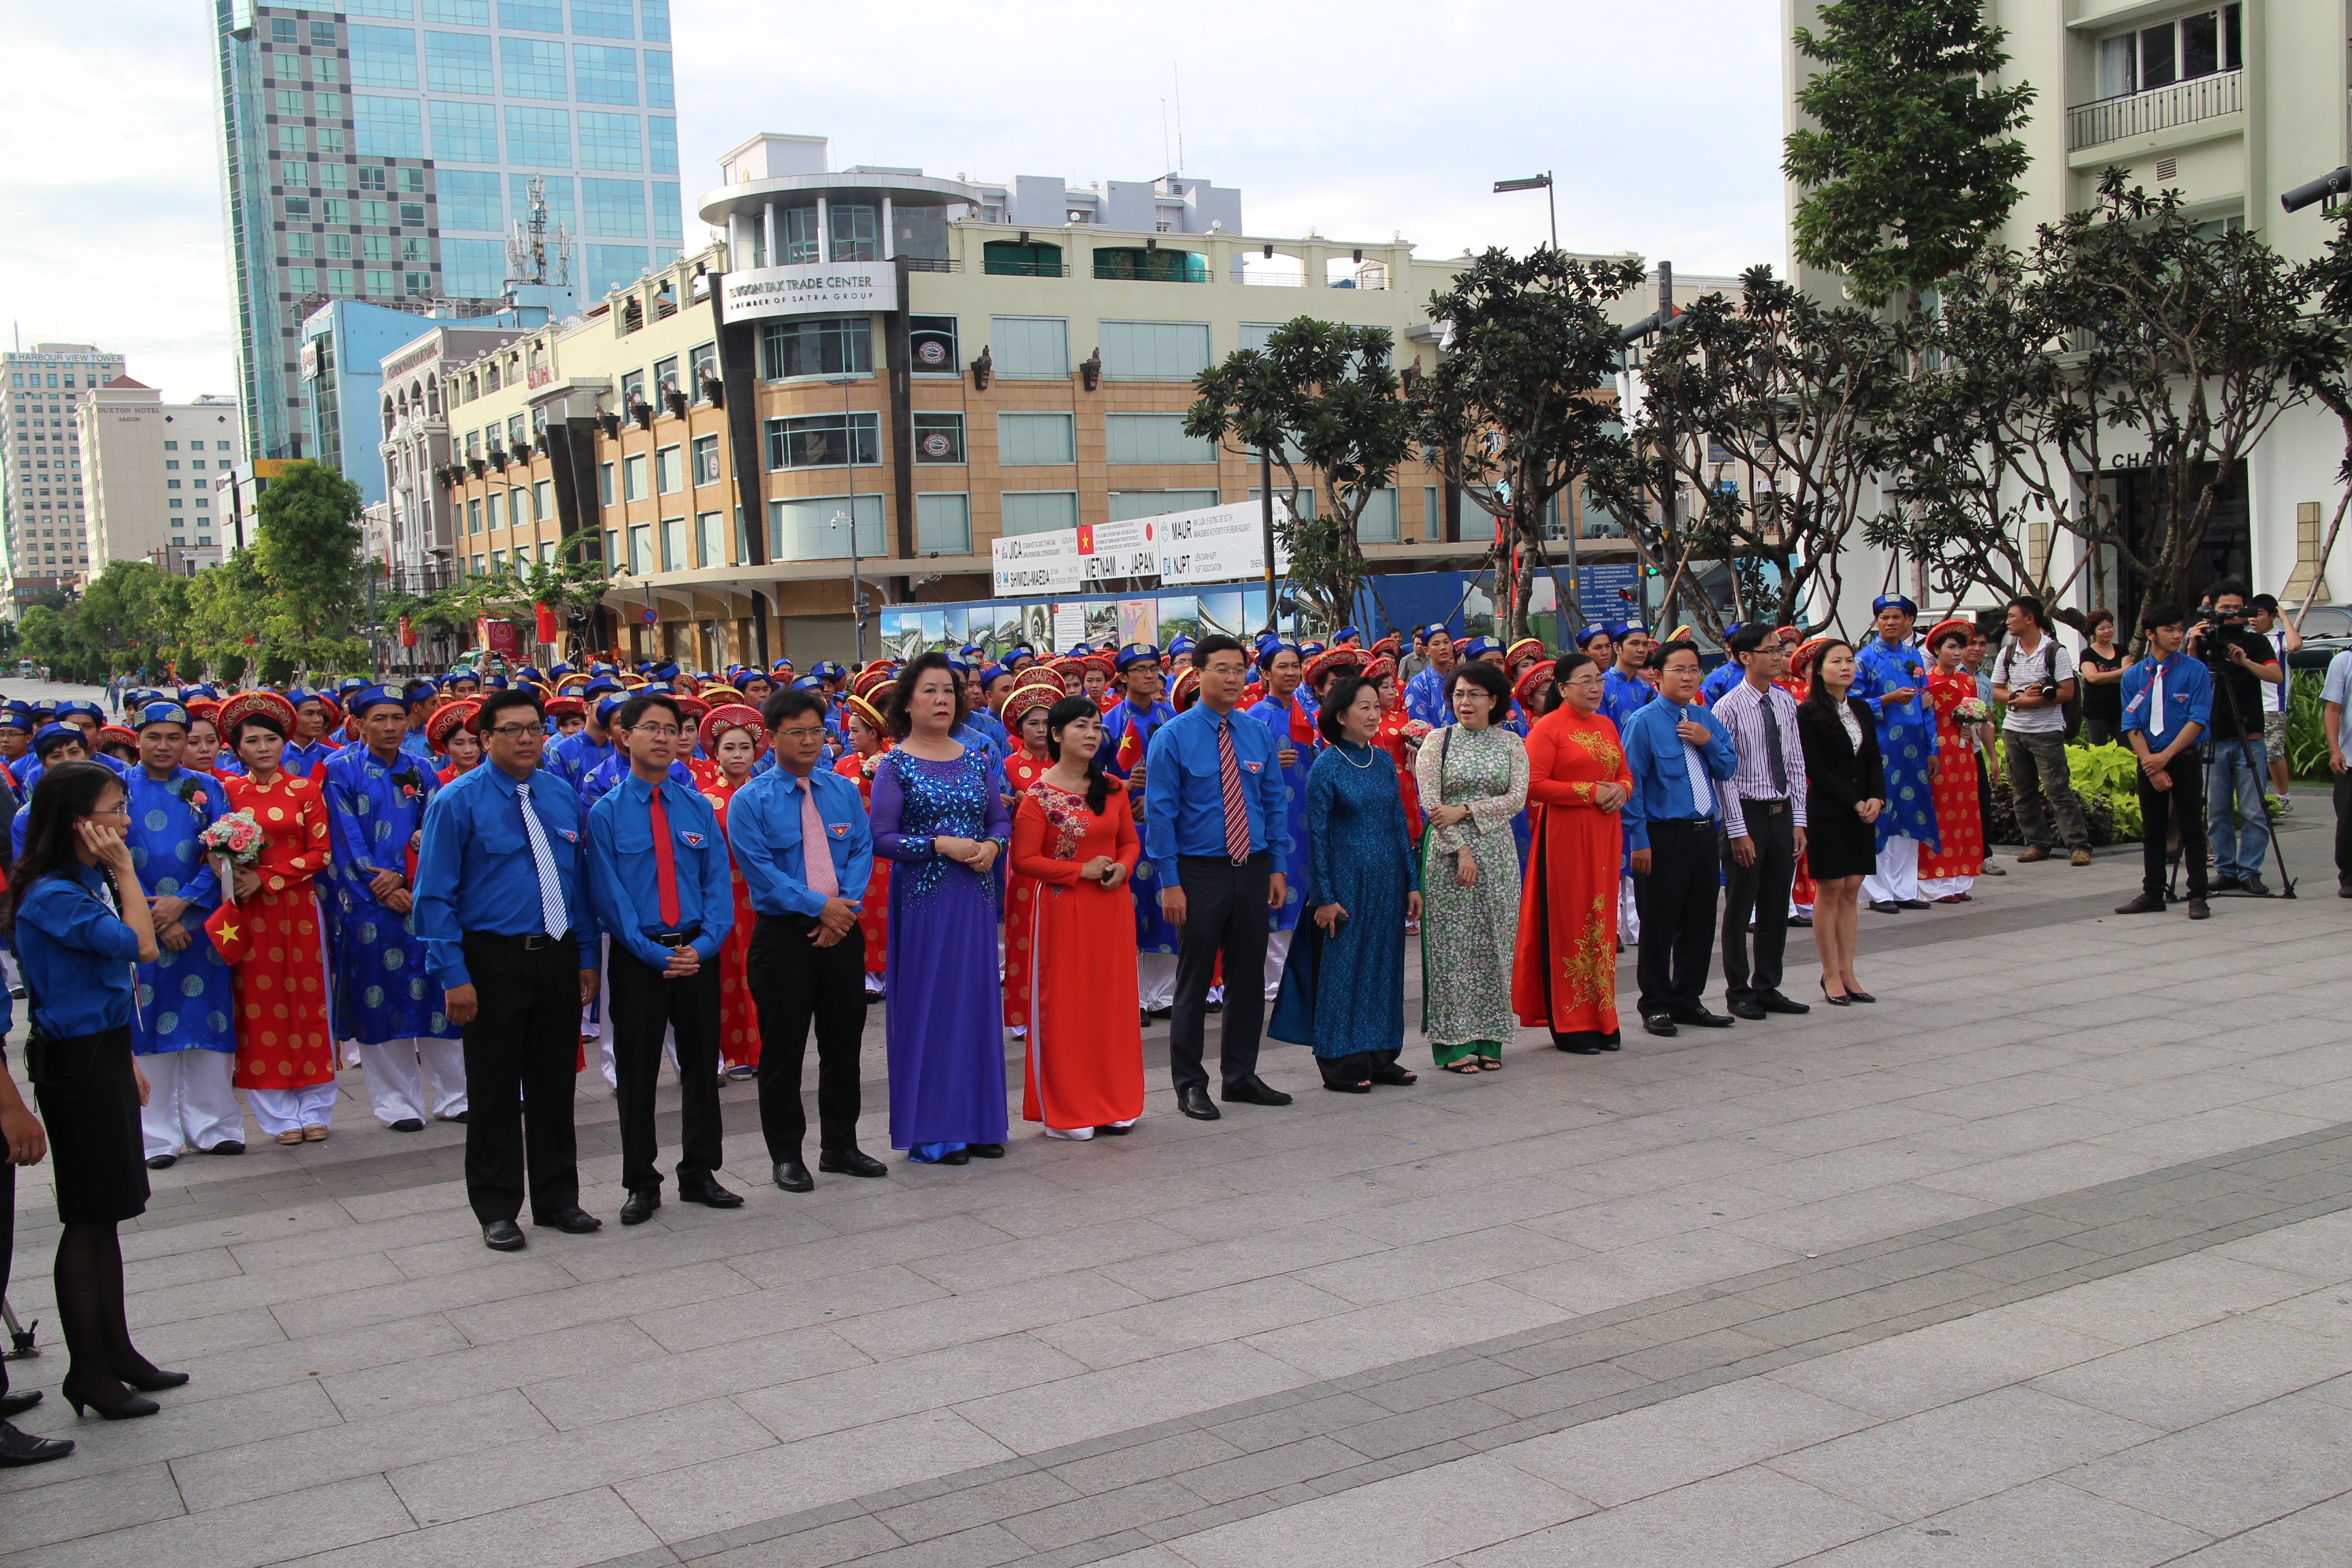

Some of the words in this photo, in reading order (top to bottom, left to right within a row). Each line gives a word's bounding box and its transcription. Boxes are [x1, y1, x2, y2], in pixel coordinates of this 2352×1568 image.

[764, 280, 784, 292] TAX
[786, 278, 822, 290] TRADE
[827, 276, 872, 287] CENTER
[736, 299, 769, 309] MEMBER
[792, 294, 828, 302] SATRA
[921, 343, 944, 352] HIGHLANDS
[926, 436, 948, 444] HIGHLANDS
[1172, 520, 1192, 540] MAUR
[1009, 541, 1022, 559] JICA
[1084, 556, 1116, 578] VIETNAM
[1130, 551, 1154, 575] JAPAN
[1173, 555, 1190, 574] NJPT
[1250, 559, 1264, 568] GENERAL
[1011, 570, 1050, 587] SHIMIZU-MAEDA
